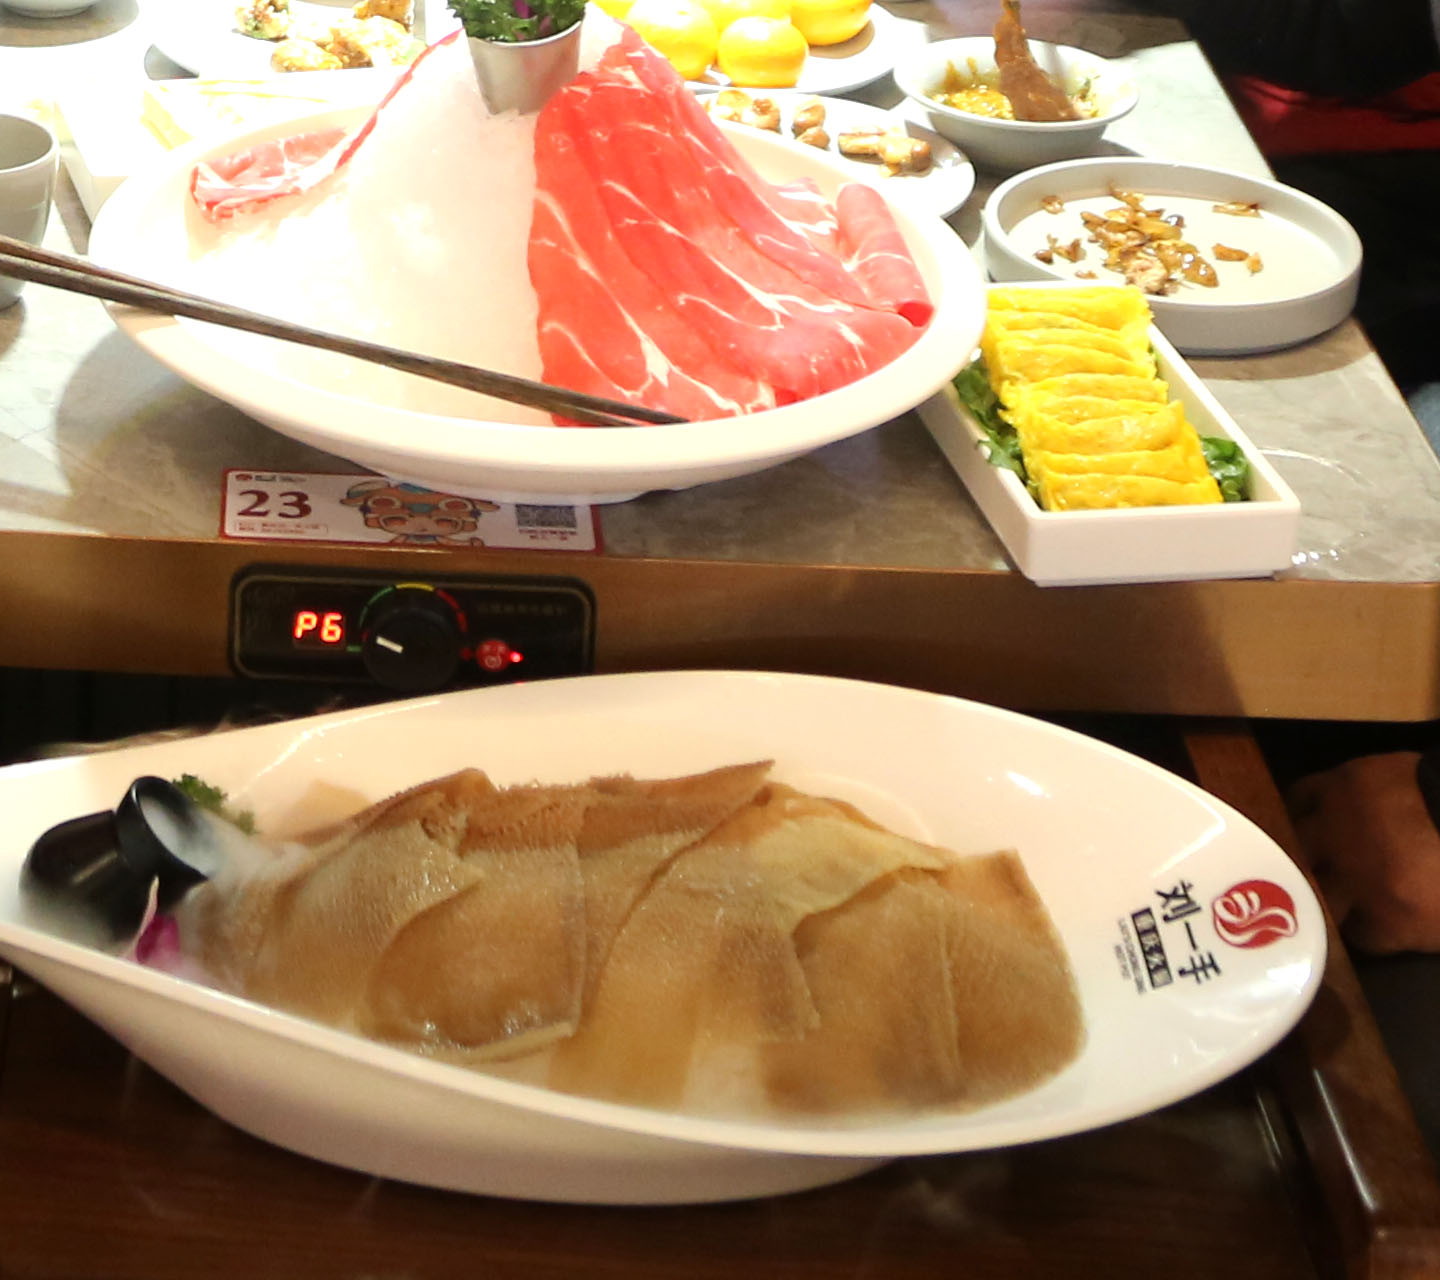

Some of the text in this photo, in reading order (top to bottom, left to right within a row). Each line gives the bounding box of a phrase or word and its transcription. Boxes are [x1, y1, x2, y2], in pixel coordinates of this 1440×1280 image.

[237, 489, 312, 518] 23
[294, 611, 343, 643] P6
[1155, 879, 1221, 984] 刘一手
